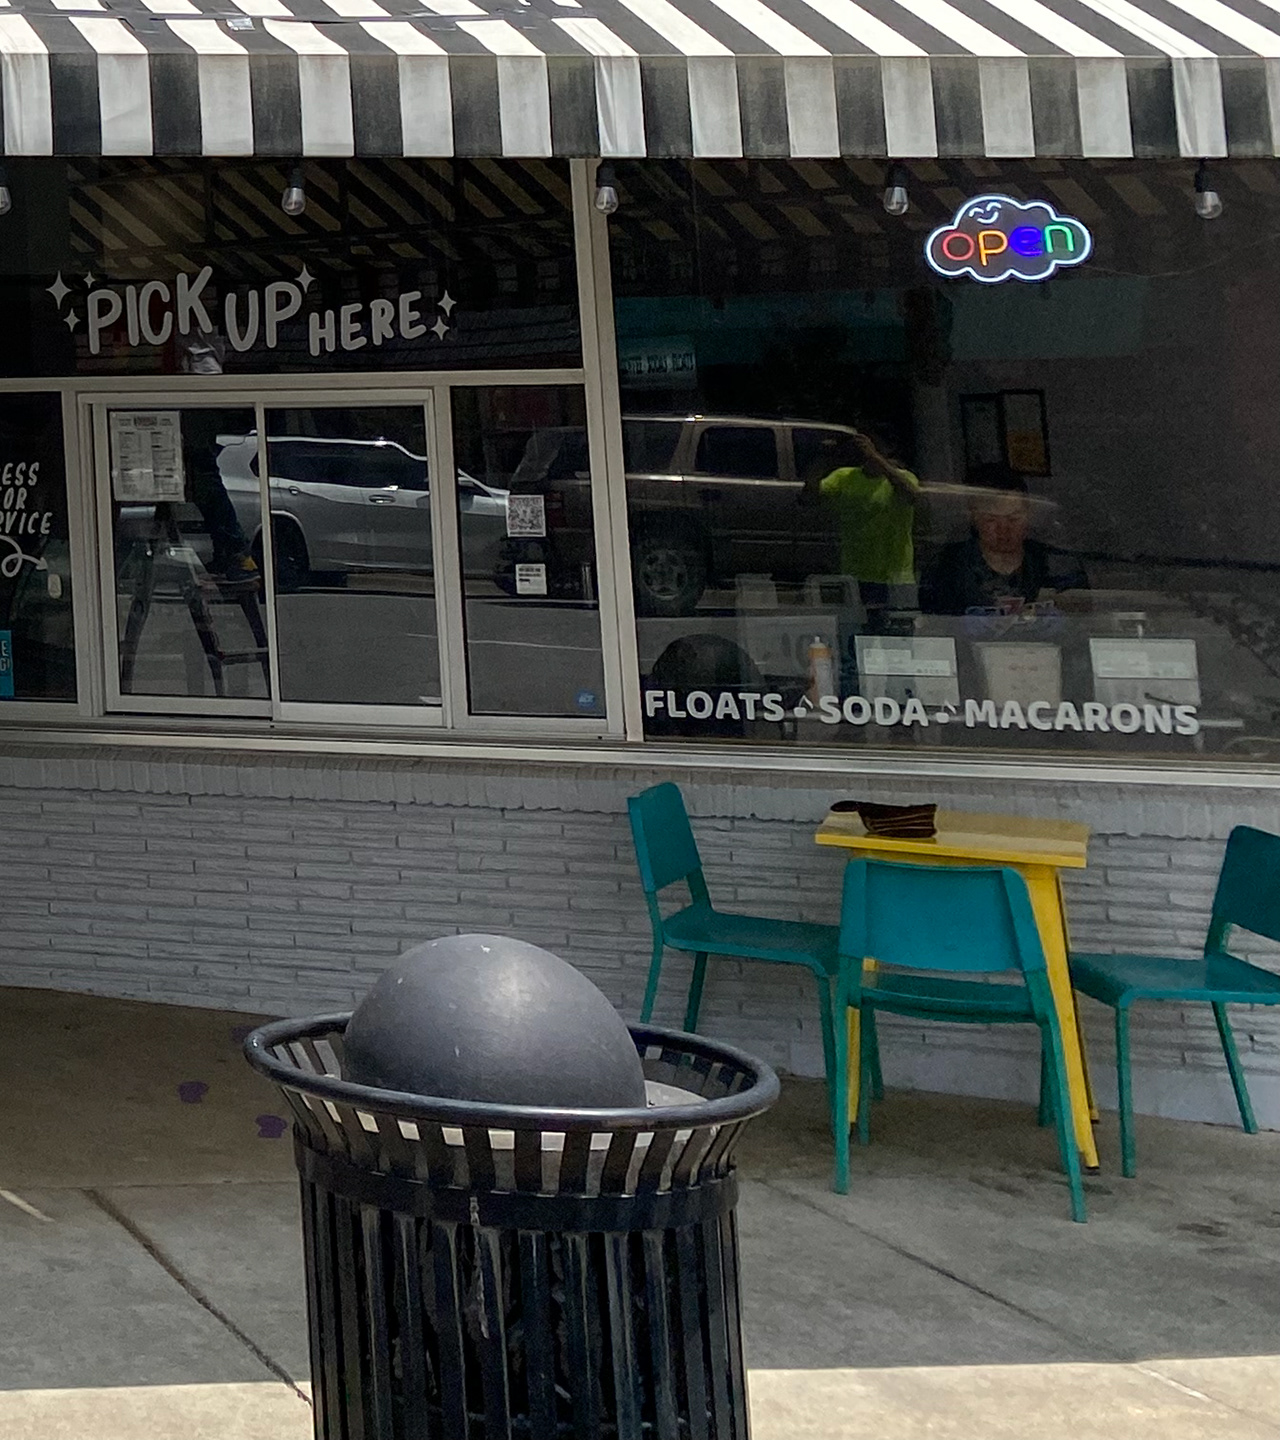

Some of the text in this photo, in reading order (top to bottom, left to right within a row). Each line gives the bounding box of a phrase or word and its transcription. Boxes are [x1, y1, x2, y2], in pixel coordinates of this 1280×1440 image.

[943, 224, 1074, 267] open
[87, 266, 427, 356] PICK UP HERE
[645, 690, 1201, 736] FLOATS SODA MACARONS
